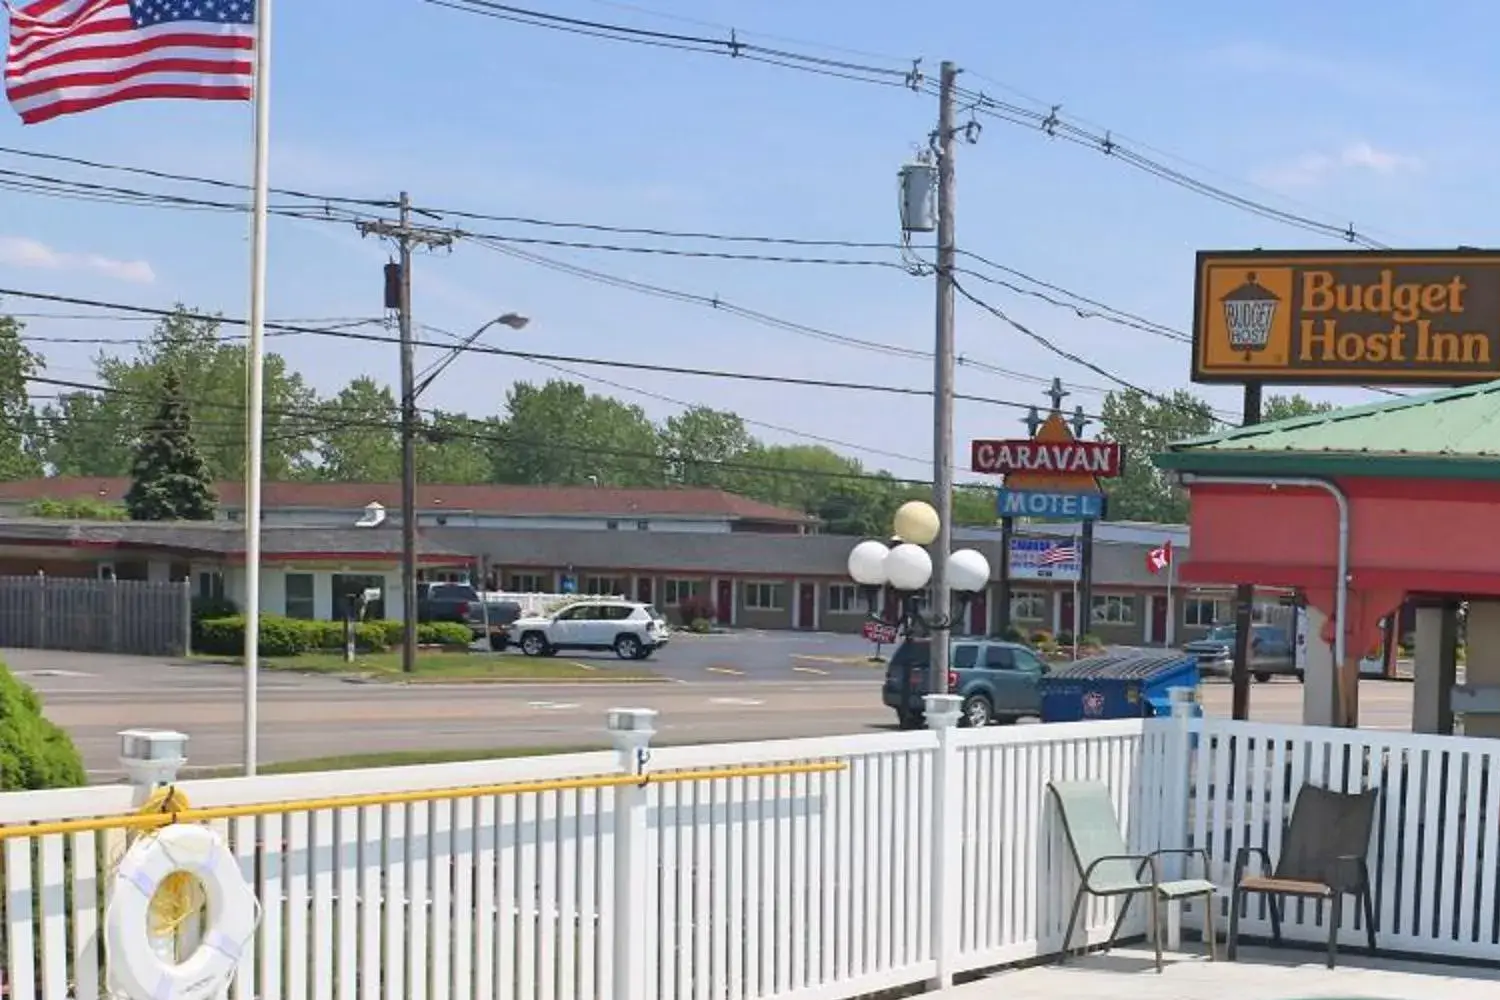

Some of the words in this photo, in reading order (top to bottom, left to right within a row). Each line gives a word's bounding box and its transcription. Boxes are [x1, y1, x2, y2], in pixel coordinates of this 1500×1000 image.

[1301, 269, 1467, 322] Budget
[1299, 319, 1407, 362] Host
[1417, 320, 1490, 363] Inn
[976, 443, 1111, 472] CARAVAN
[1003, 491, 1097, 516] MOTEL
